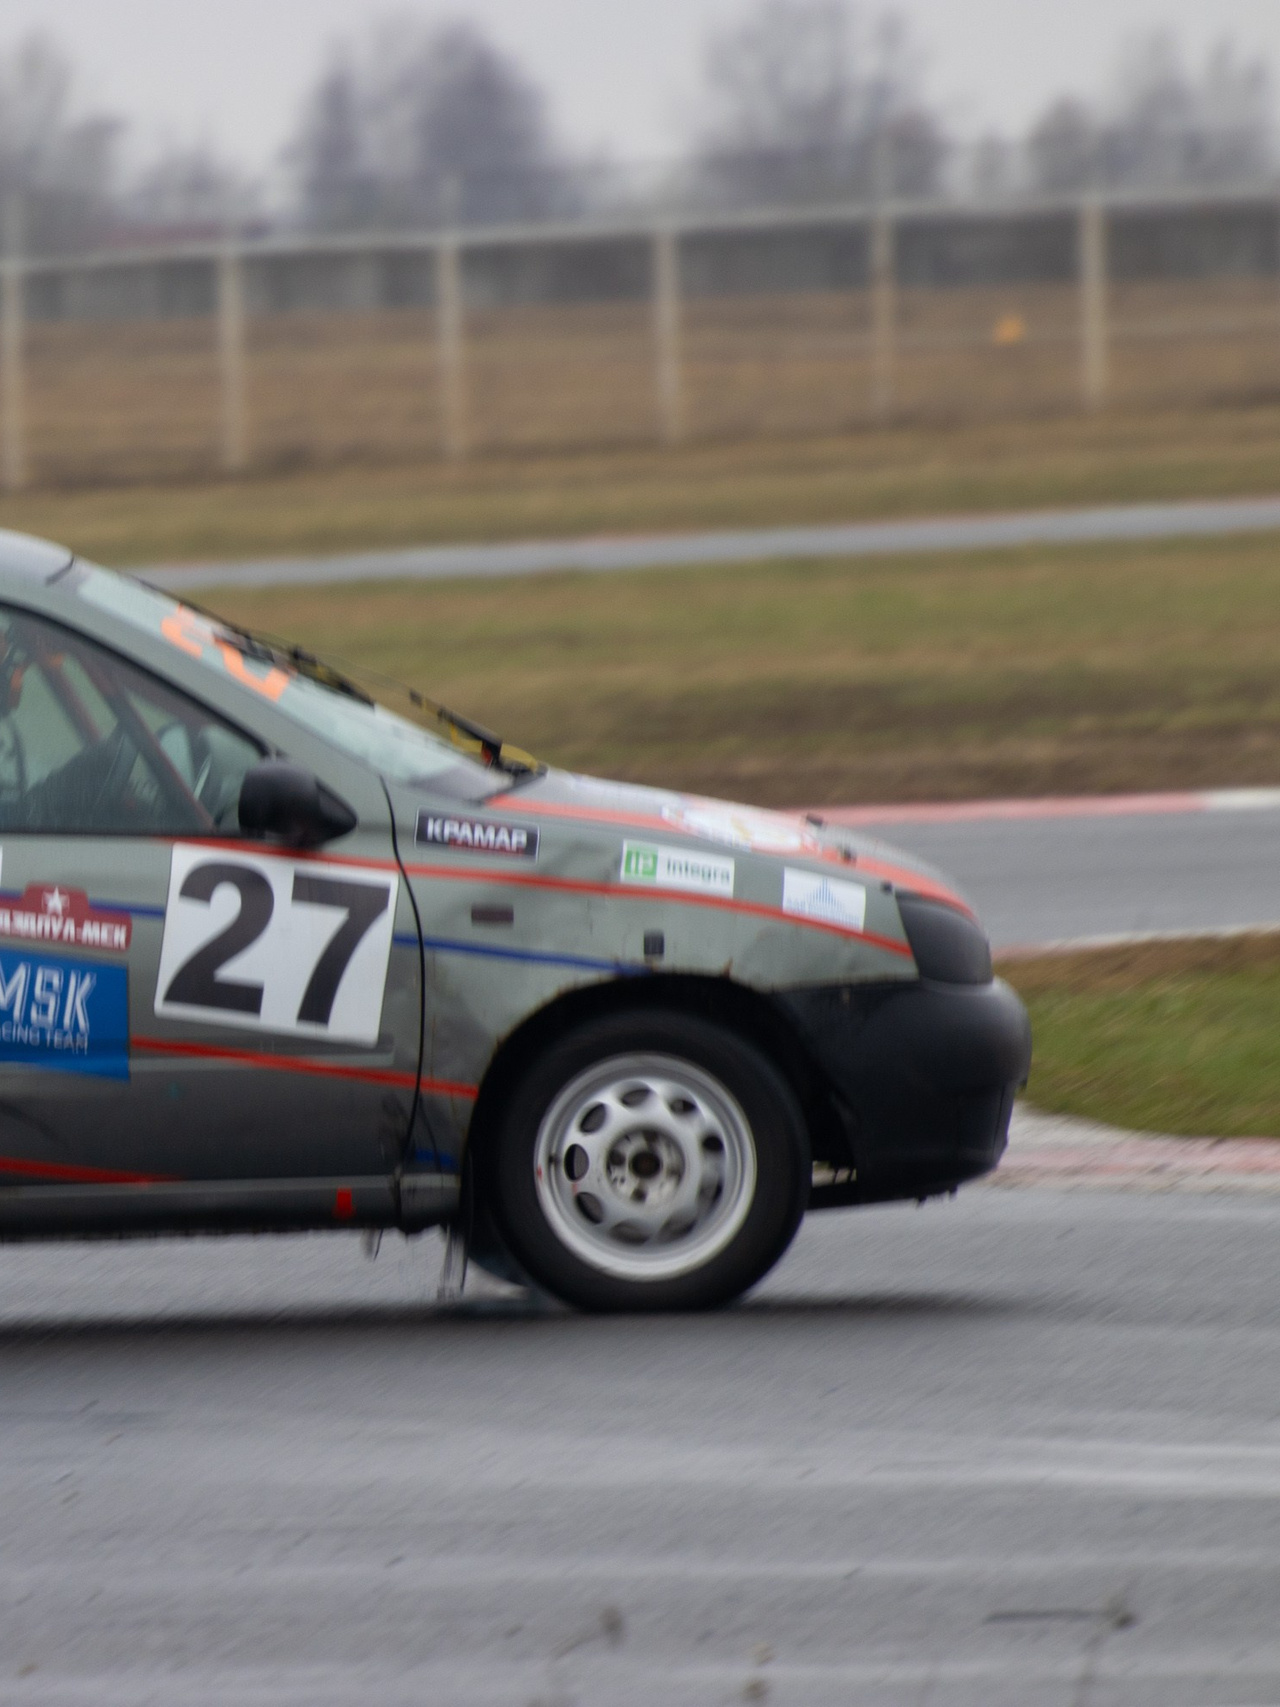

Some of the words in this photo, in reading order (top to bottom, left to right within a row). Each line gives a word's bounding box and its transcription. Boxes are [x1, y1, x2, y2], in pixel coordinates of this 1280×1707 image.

[666, 857, 731, 885] Integra
[162, 859, 392, 1029] 27
[45, 1028, 89, 1056] TEAM
